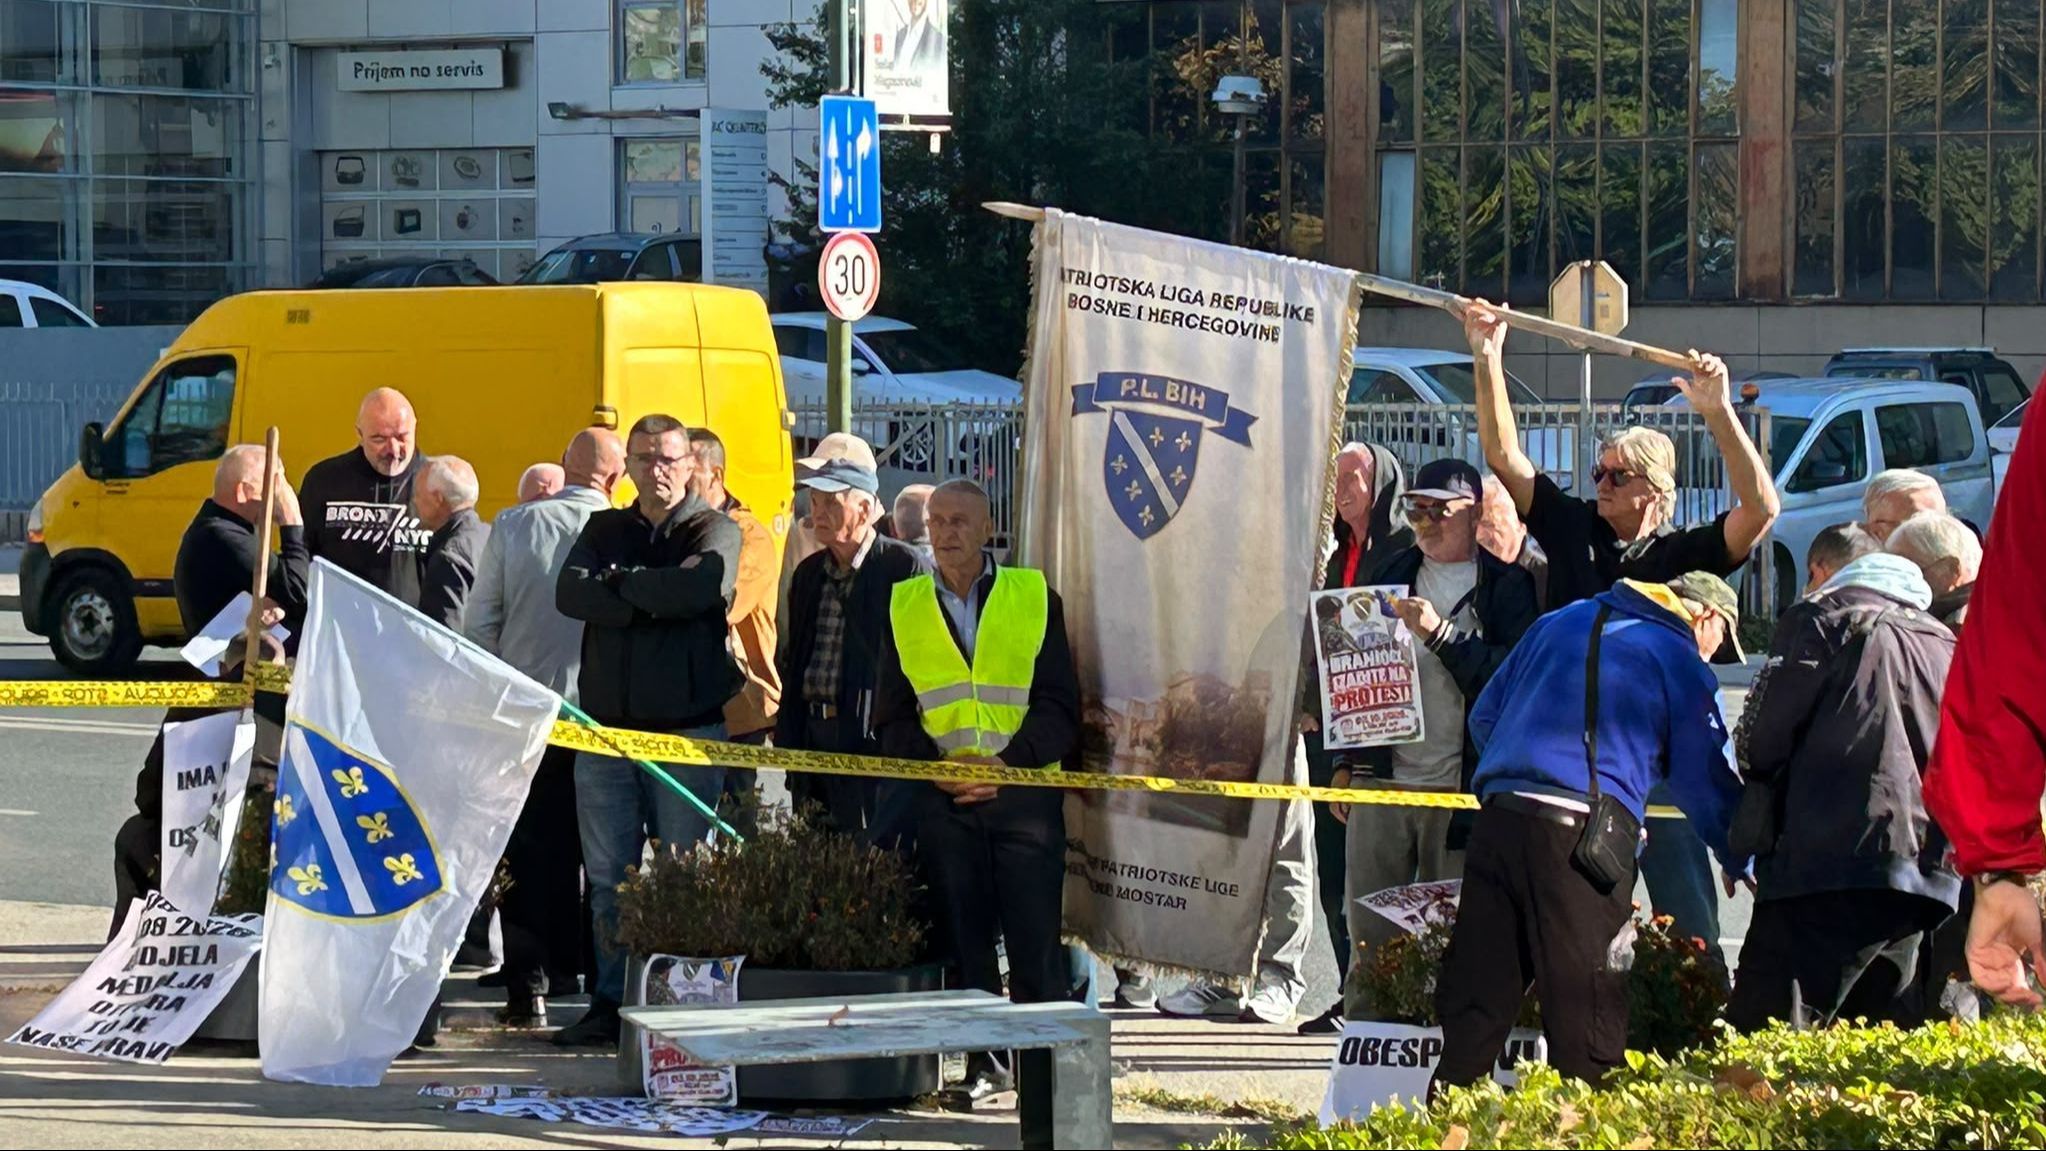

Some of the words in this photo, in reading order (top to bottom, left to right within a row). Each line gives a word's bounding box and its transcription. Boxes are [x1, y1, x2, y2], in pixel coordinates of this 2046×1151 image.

[353, 61, 405, 83] Prijem
[436, 60, 484, 78] servis
[835, 254, 865, 295] 30
[1067, 292, 1132, 319] BOSNE
[1148, 305, 1281, 344] HERCEGOVINE
[1159, 284, 1206, 307] LIGA
[1209, 292, 1315, 325] REPUBLIKE
[1165, 379, 1206, 411] BIH
[325, 506, 389, 523] BRONX
[176, 764, 217, 792] IMA
[1116, 885, 1188, 911] MOSTAR
[1204, 878, 1240, 898] LIGE
